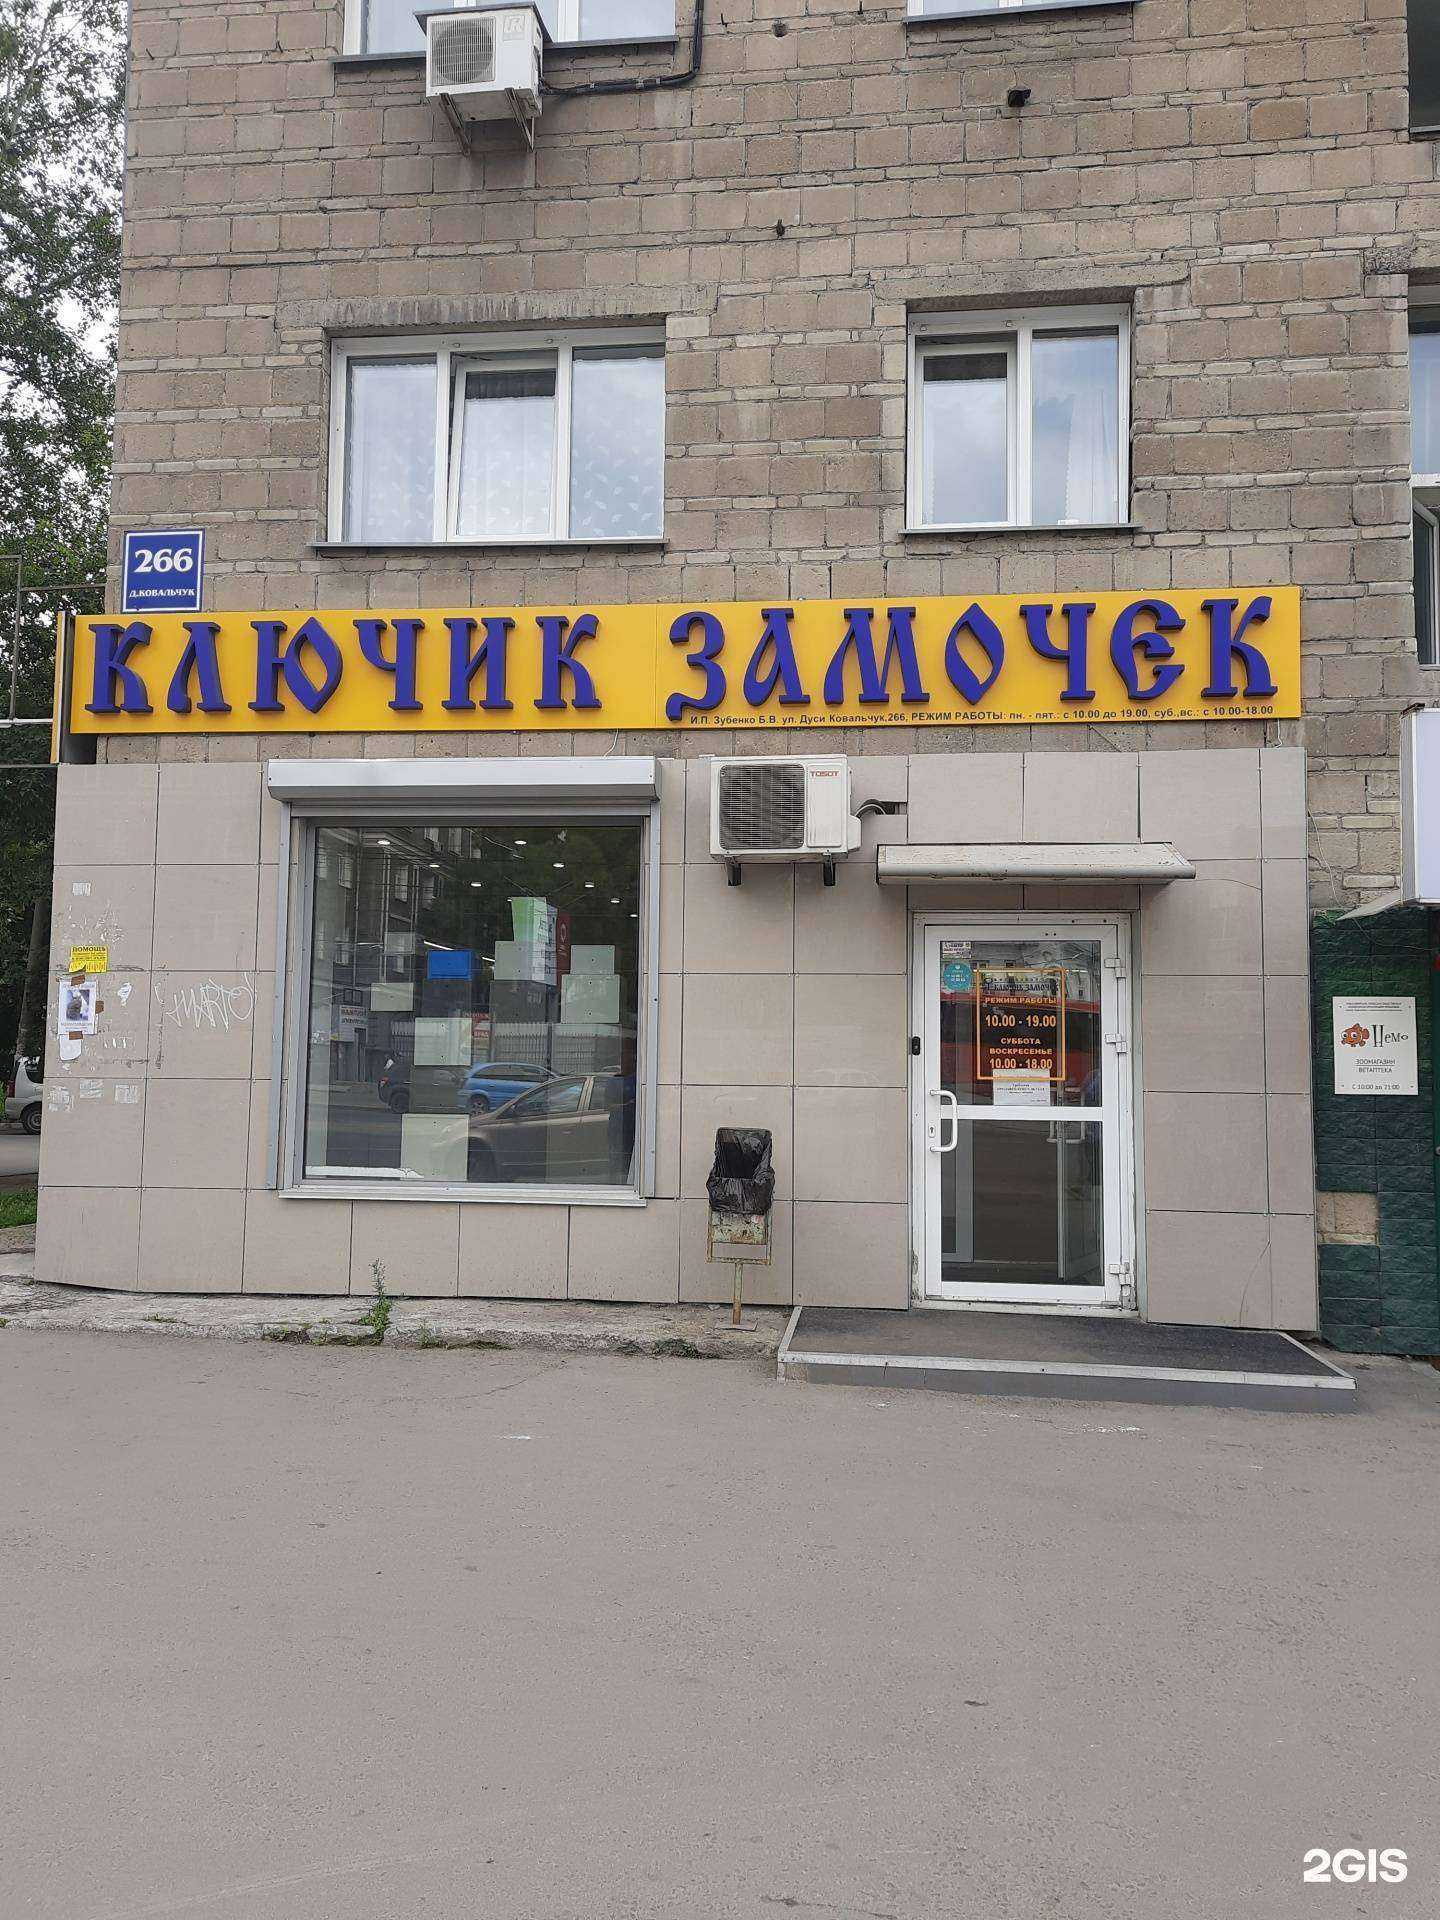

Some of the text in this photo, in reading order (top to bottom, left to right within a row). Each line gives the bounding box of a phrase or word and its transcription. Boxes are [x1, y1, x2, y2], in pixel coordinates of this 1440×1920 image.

[134, 548, 194, 573] 266
[129, 588, 196, 598] Д.КОВАЛЬЧУК
[84, 596, 1279, 722] КЛЮЧИК ЗАМОЧЕК
[714, 715, 756, 726] Зубенко
[758, 715, 779, 724] Б.В.
[782, 716, 797, 726] ул.
[800, 714, 826, 725] Дуси
[911, 711, 952, 721] РЕЖИМ
[954, 710, 1007, 720] РАБОТЫ:
[1009, 711, 1026, 719] пн.
[1063, 711, 1070, 719] с
[1073, 709, 1100, 719] 10.00
[1103, 710, 1117, 720] до
[1203, 708, 1210, 716] с
[1213, 705, 1274, 716] 10.00-18.00
[985, 1014, 1016, 1027] 10.00
[1026, 1014, 1057, 1027] 19.00
[1000, 1037, 1041, 1045] СУББОТА
[989, 1058, 1017, 1069] 10.00
[1025, 1058, 1053, 1069] 18.00
